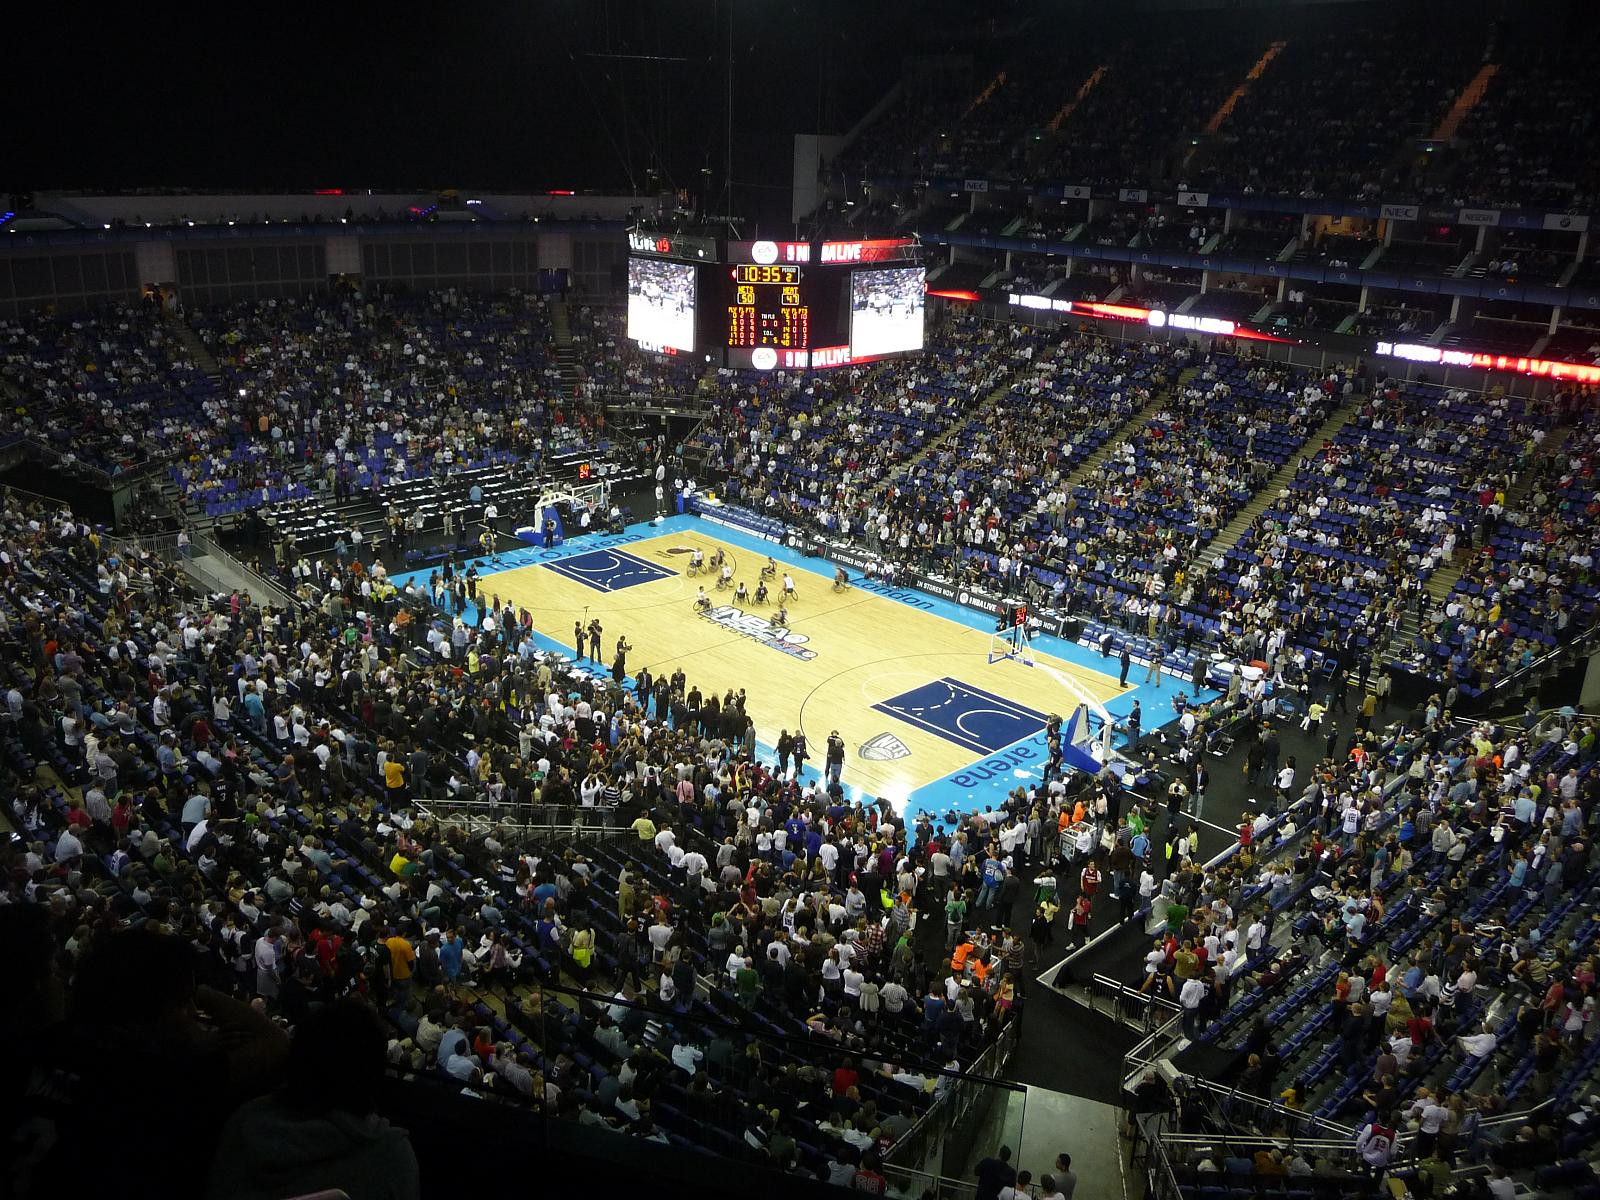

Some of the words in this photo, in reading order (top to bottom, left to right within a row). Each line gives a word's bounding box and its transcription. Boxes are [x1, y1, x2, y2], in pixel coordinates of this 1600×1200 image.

[1384, 207, 1415, 217] NEC
[837, 244, 862, 261] LIVE
[745, 266, 780, 282] 10:35
[786, 273, 792, 282] 2
[738, 286, 754, 294] NETS
[783, 287, 799, 295] HEAT
[742, 294, 753, 303] 50
[787, 295, 798, 304] 47
[827, 347, 851, 365] LIVE
[576, 533, 644, 552] arena
[831, 551, 837, 559] IN
[837, 554, 854, 565] STORES
[854, 559, 864, 568] NOW
[848, 578, 934, 609] London
[923, 581, 942, 594] STORES
[942, 588, 955, 598] NOW
[983, 600, 997, 612] LIVE
[713, 606, 791, 641] NBA
[1015, 613, 1025, 625] 24
[1043, 621, 1057, 631] NOW
[870, 734, 911, 759] NETS
[950, 746, 1038, 788] arena
[220, 792, 226, 802] 3
[639, 924, 644, 932] 3
[1157, 984, 1162, 993] 3
